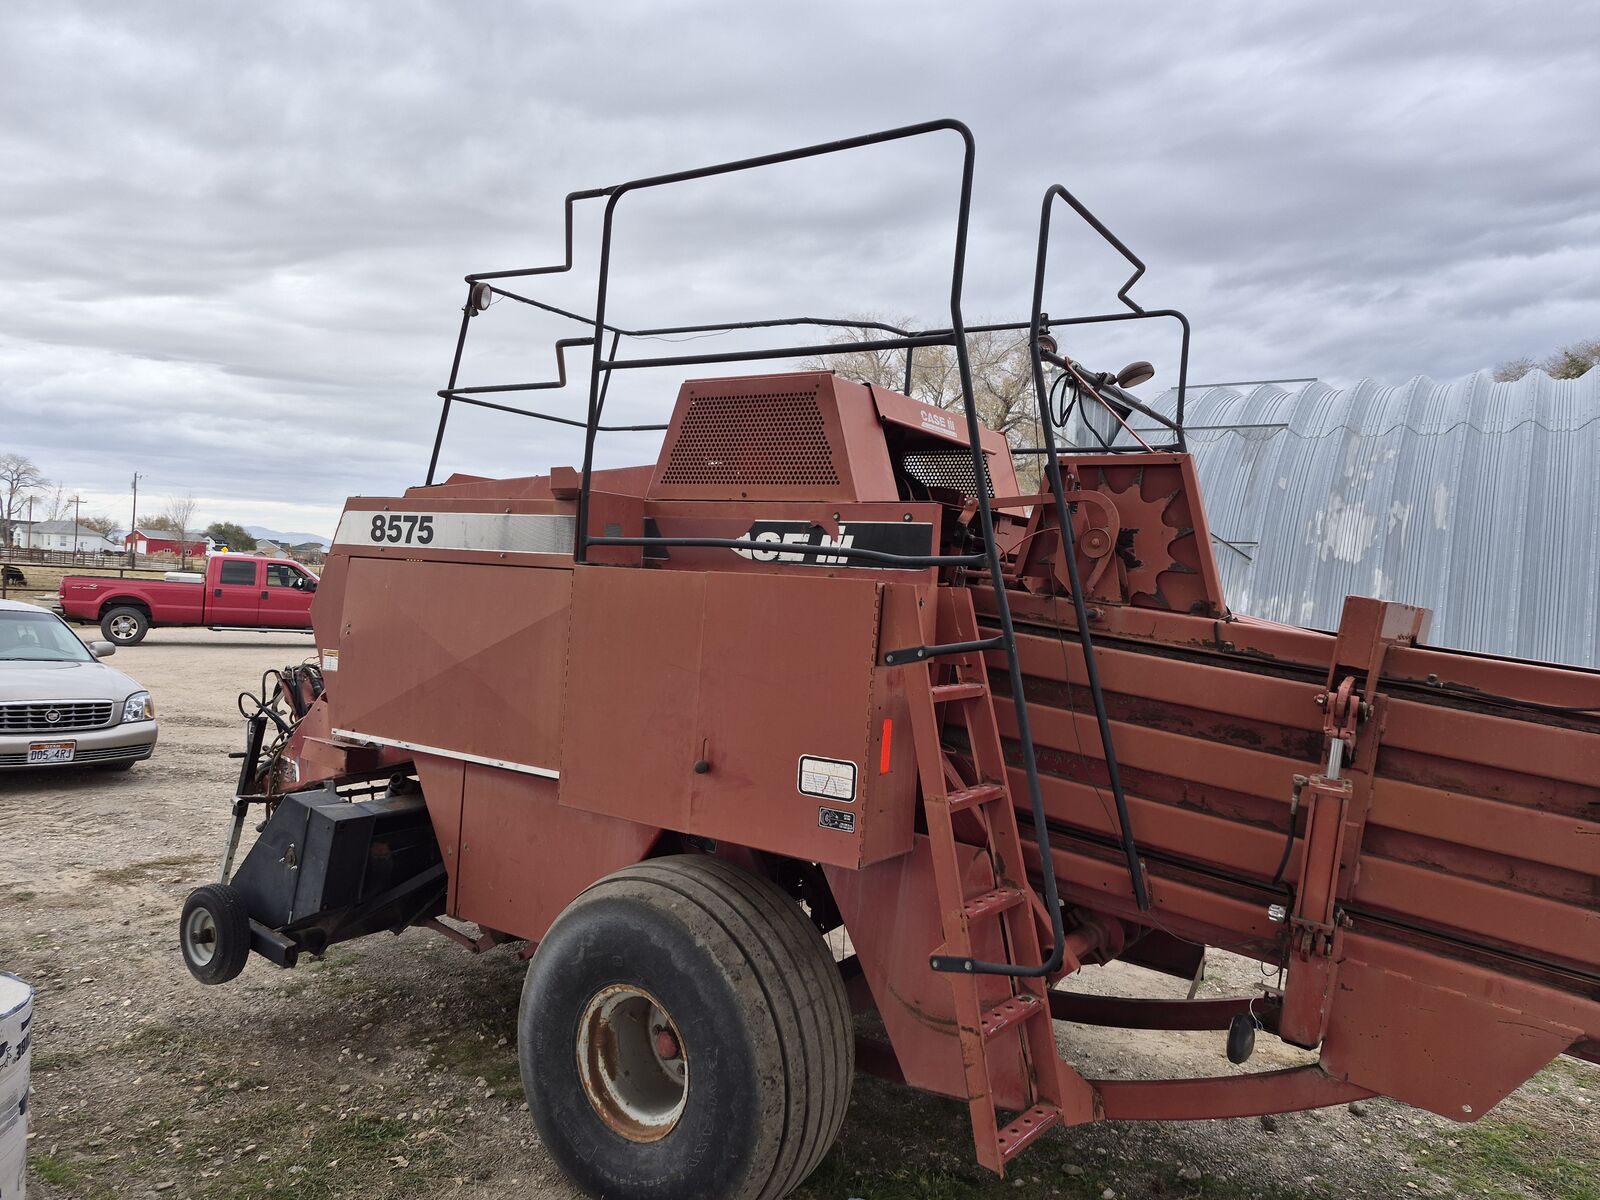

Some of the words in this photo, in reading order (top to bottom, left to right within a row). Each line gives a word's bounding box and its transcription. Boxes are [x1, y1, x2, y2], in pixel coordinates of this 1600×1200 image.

[920, 410, 946, 428] CASE
[370, 514, 434, 545] 8575
[54, 749, 72, 759] 4RJ
